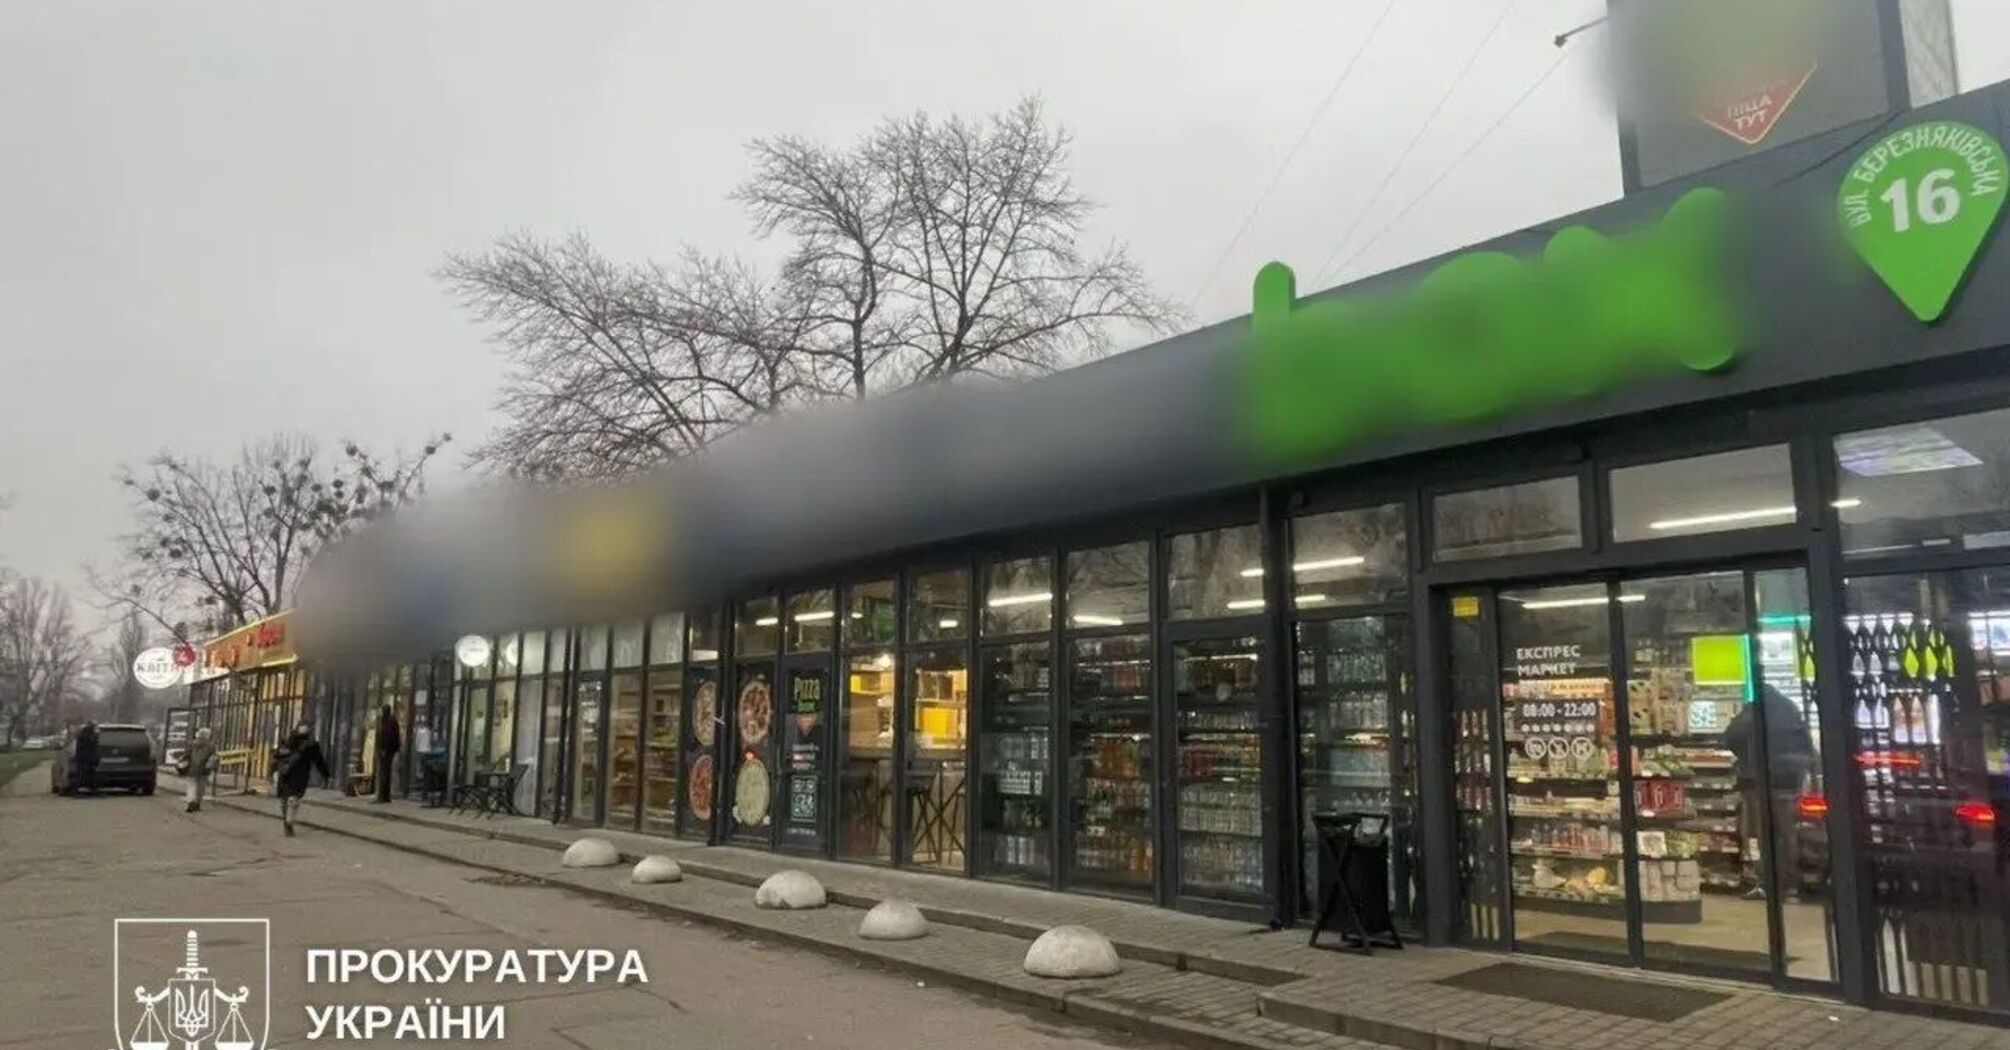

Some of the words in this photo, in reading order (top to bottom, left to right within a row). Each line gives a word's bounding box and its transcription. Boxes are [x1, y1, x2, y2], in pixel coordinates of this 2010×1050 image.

[1735, 109, 1768, 130] ТУТ
[1853, 126, 2000, 196] БЕРЕЗНЯКІВСЬКА
[1844, 189, 1872, 228] ВУЛ.
[1880, 168, 1961, 232] 16
[1516, 645, 1581, 660] ЕКСПРЕС
[1517, 662, 1577, 676] МАРКЕТ
[1523, 703, 1556, 717] 08:00
[1564, 702, 1597, 717] 22:00
